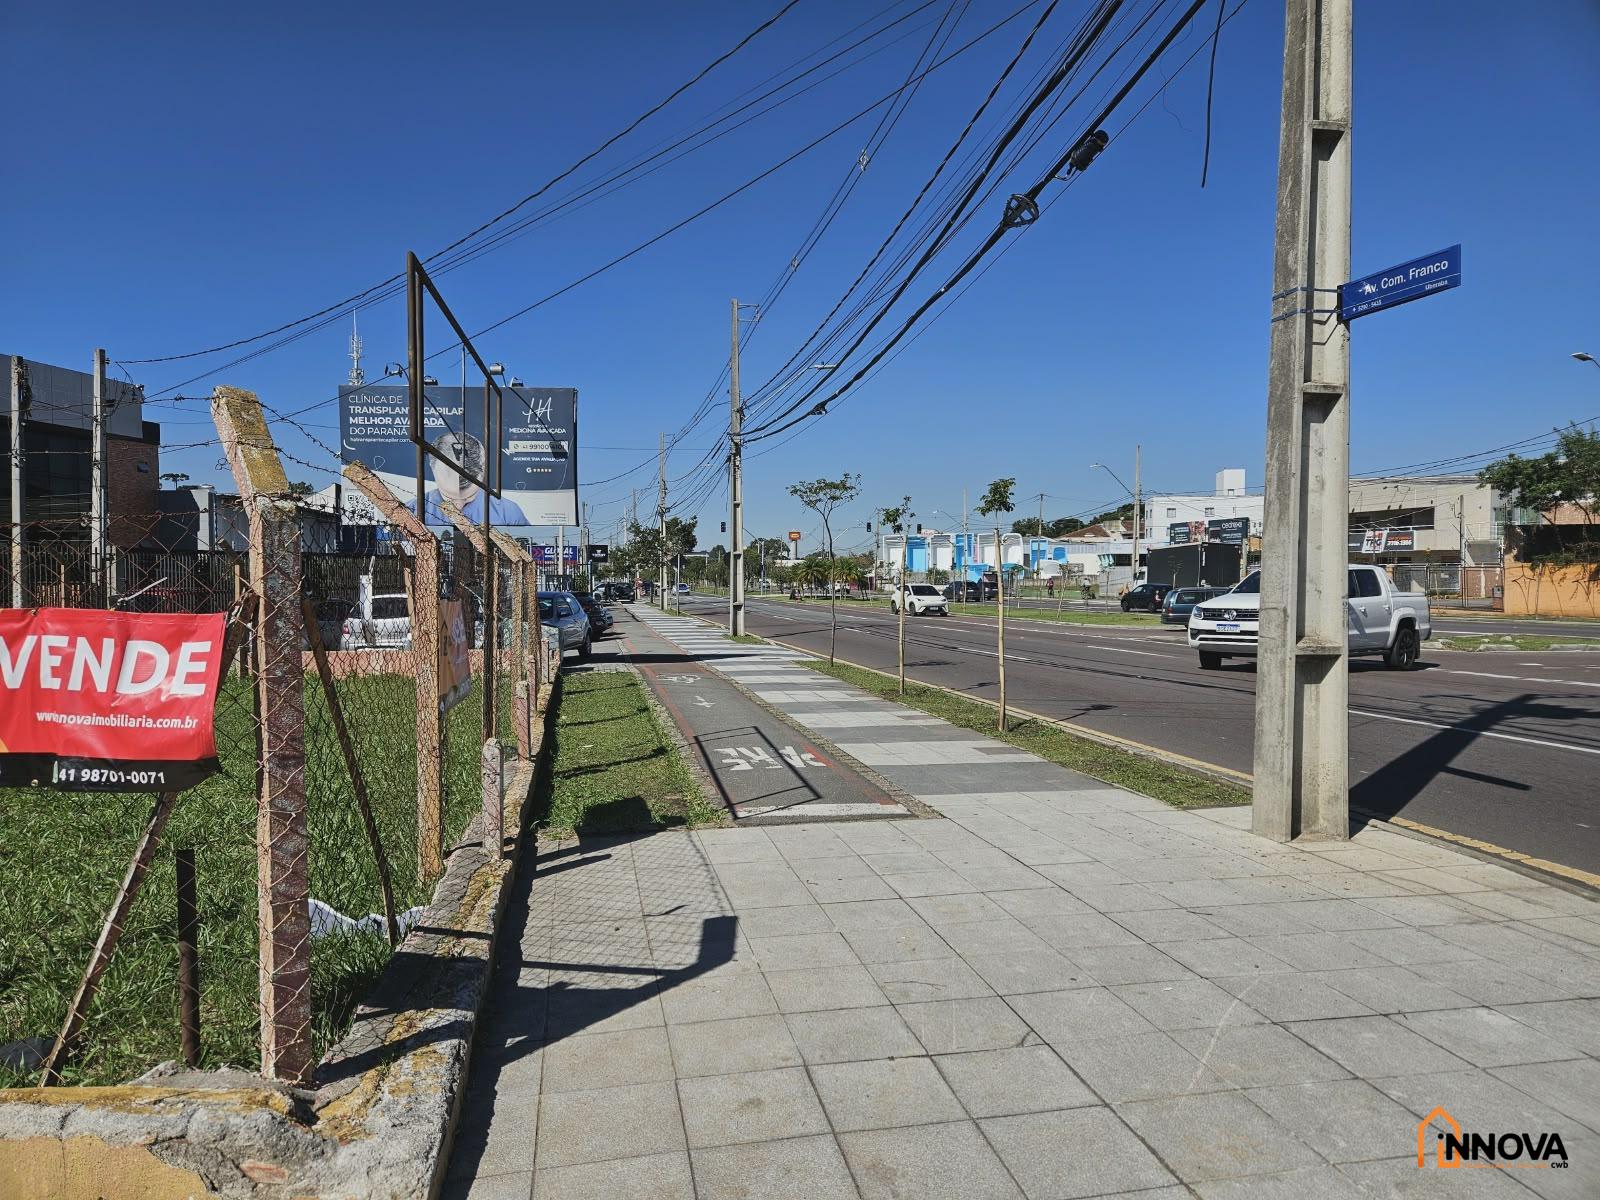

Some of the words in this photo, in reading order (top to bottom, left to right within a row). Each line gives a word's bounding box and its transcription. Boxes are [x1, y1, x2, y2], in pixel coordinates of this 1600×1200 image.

[1364, 283, 1378, 296] Av.
[1381, 275, 1406, 289] Com.
[1409, 260, 1449, 281] Franco
[348, 394, 387, 404] CLÍNICA
[389, 395, 403, 404] DE
[423, 407, 465, 416] CAPILAR
[349, 417, 392, 425] MELHOR
[350, 426, 366, 436] DO
[367, 426, 408, 436] PARANÁ
[0, 635, 212, 698] VENDE
[58, 767, 75, 781] 41
[80, 768, 166, 784] 98701-0071
